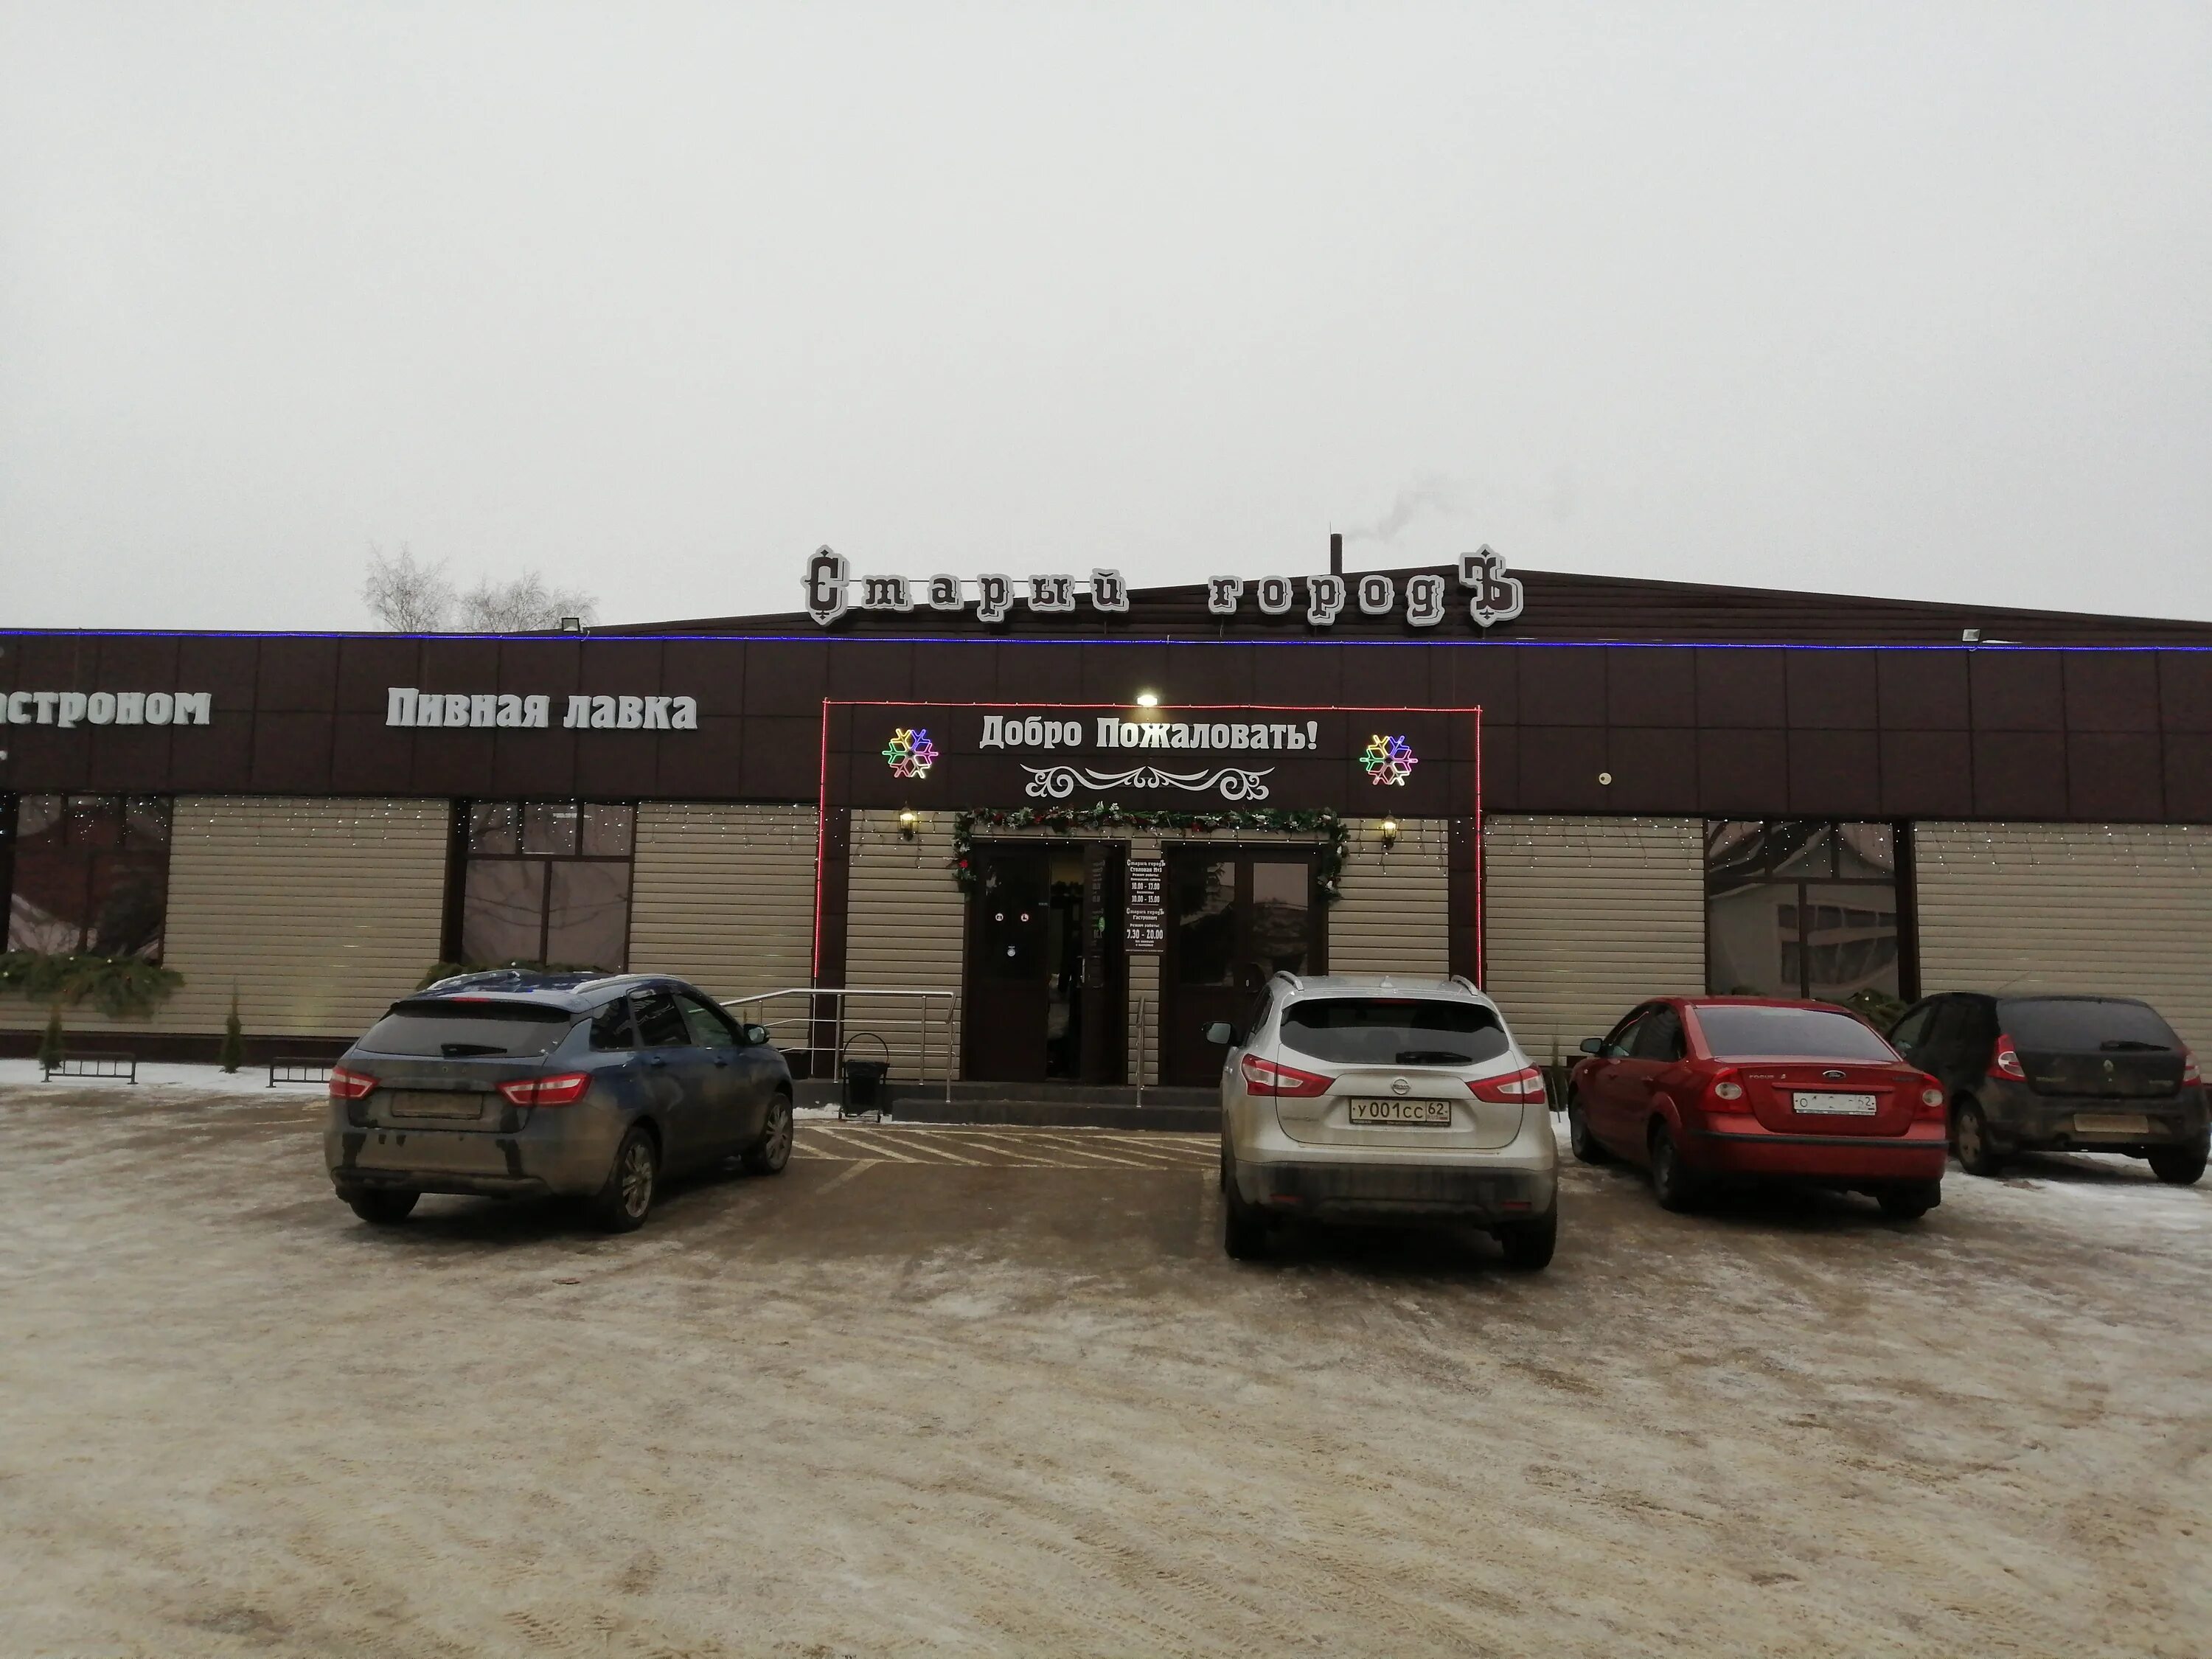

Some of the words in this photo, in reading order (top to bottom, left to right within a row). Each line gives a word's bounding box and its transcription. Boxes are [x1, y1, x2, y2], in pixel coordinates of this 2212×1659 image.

[801, 544, 1130, 625] Старый
[0, 691, 212, 728] строном
[386, 687, 550, 728] Пивная
[563, 695, 698, 729] лавка
[979, 715, 1082, 749] Добро
[1096, 717, 1318, 750] Пожаловать!
[1131, 882, 1144, 890] 10.00
[1127, 929, 1140, 939] 7.30
[1147, 929, 1164, 939] 20.00
[1428, 1102, 1444, 1114] 62
